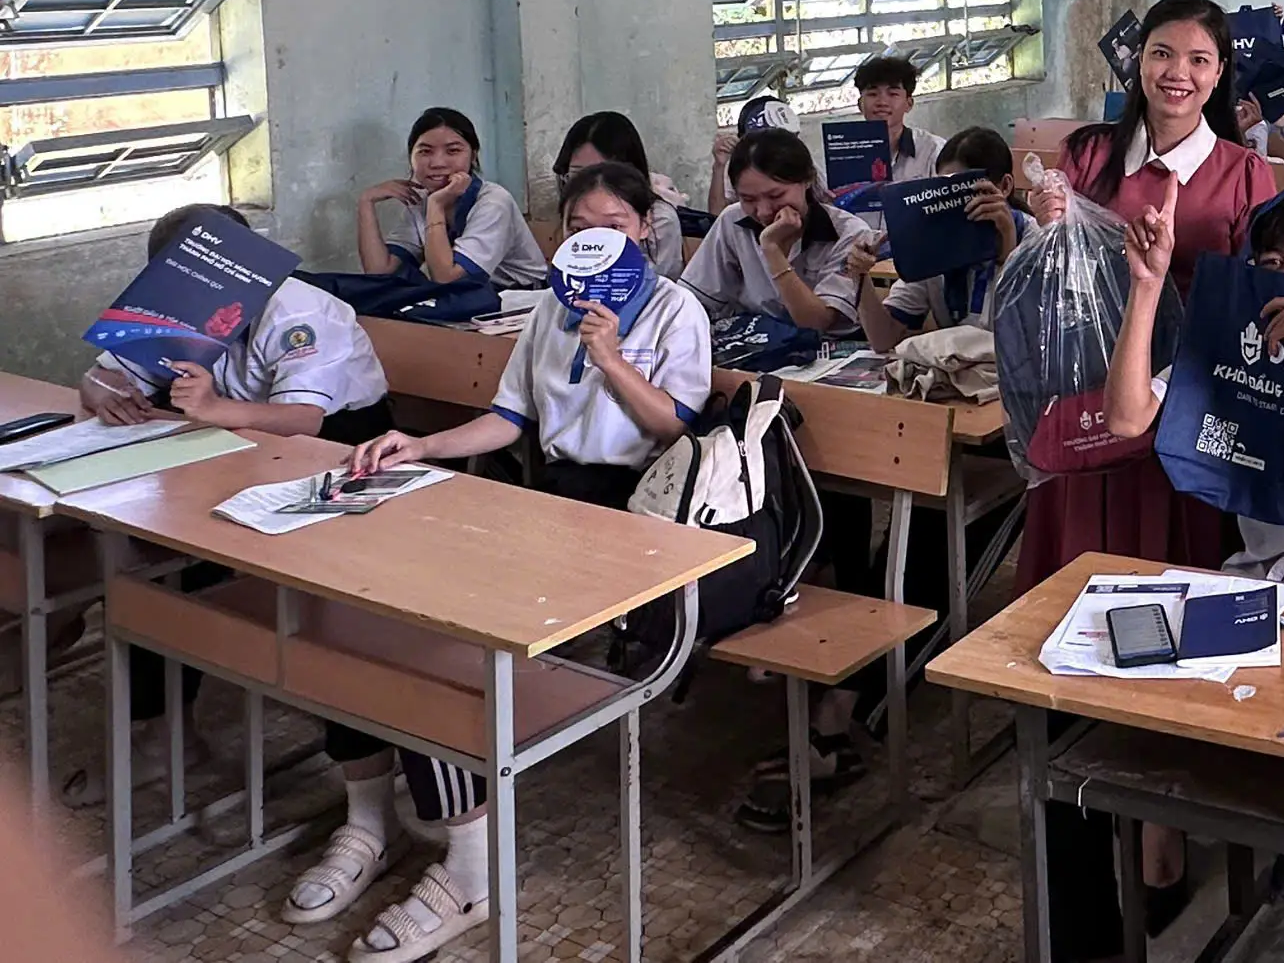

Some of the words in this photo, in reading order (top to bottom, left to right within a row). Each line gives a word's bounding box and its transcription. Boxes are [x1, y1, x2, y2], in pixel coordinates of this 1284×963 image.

[1231, 38, 1256, 50] HV
[903, 185, 950, 206] TRƯỜNG
[922, 197, 962, 215] THÀNH
[201, 231, 223, 245] DHV
